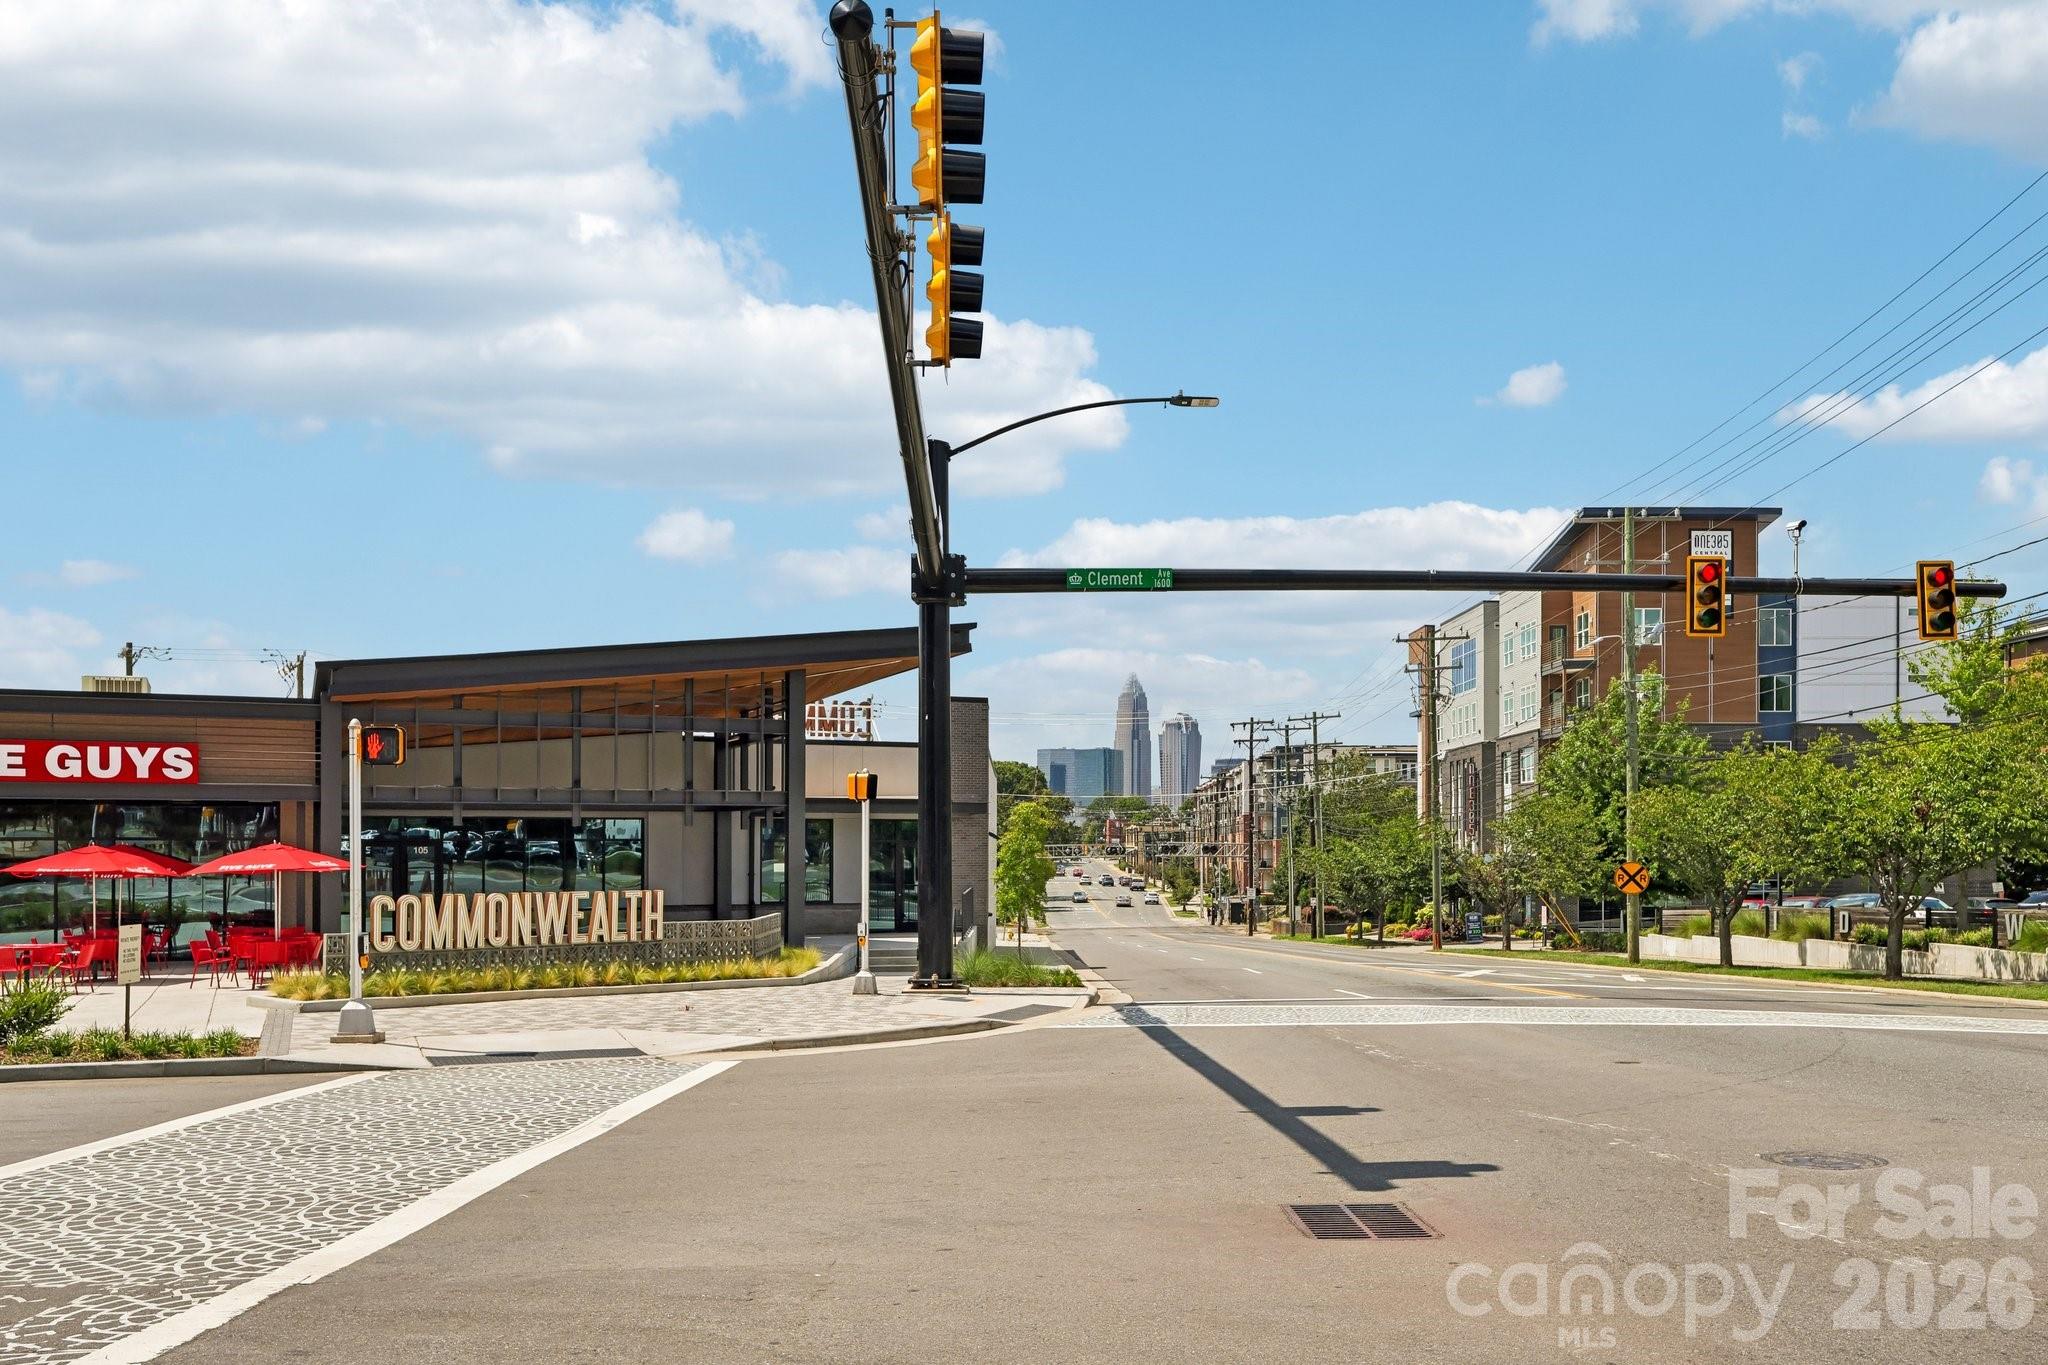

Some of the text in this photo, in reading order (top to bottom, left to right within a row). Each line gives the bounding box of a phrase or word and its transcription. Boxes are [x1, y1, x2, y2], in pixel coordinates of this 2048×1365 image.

[1088, 569, 1171, 586] Clement Ave
[1154, 578, 1171, 588] 1600
[45, 744, 194, 780] GUYS
[413, 846, 429, 855] 105
[1617, 874, 1647, 882] R R
[369, 889, 664, 952] COMMONWEALTH
[2004, 913, 2025, 941] W
